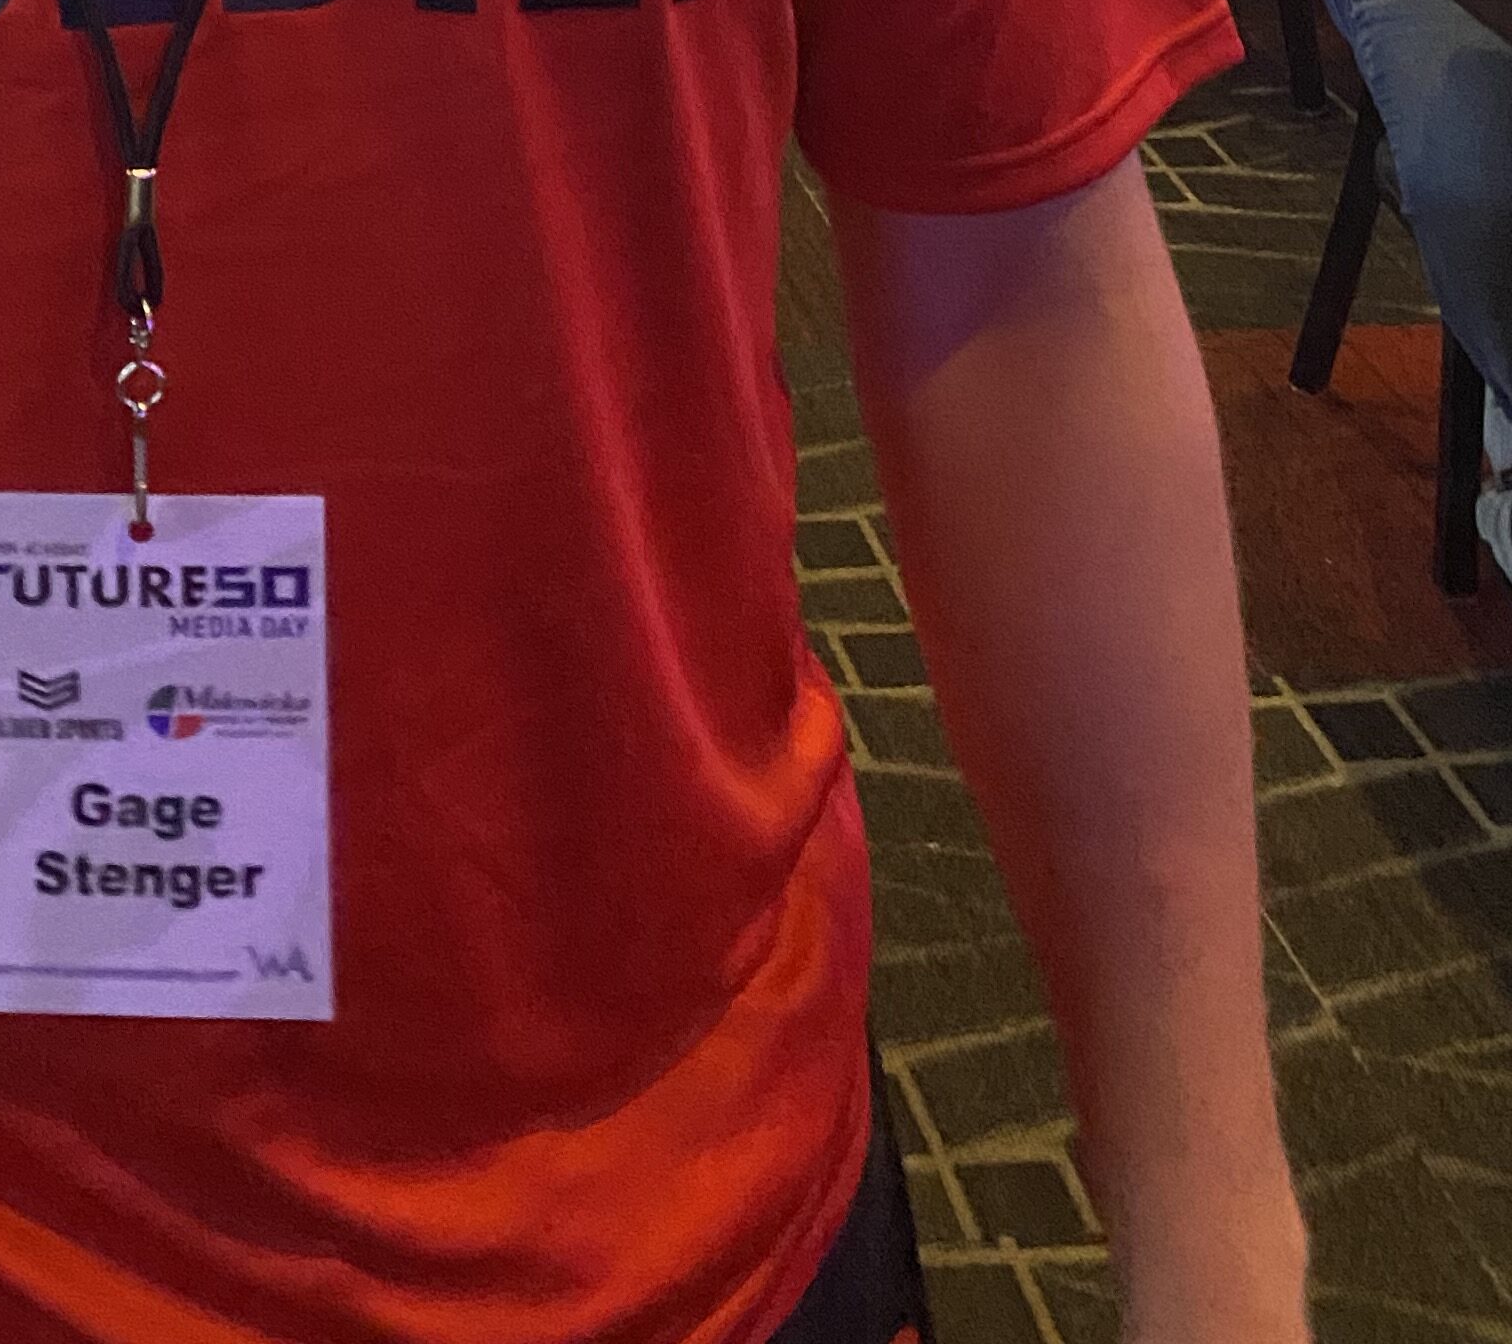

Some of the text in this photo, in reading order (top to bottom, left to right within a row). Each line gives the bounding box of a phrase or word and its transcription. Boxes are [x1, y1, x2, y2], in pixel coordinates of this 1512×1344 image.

[170, 615, 309, 638] MEDIA DAY
[71, 783, 223, 840] Gage
[35, 850, 264, 910] Stenger
